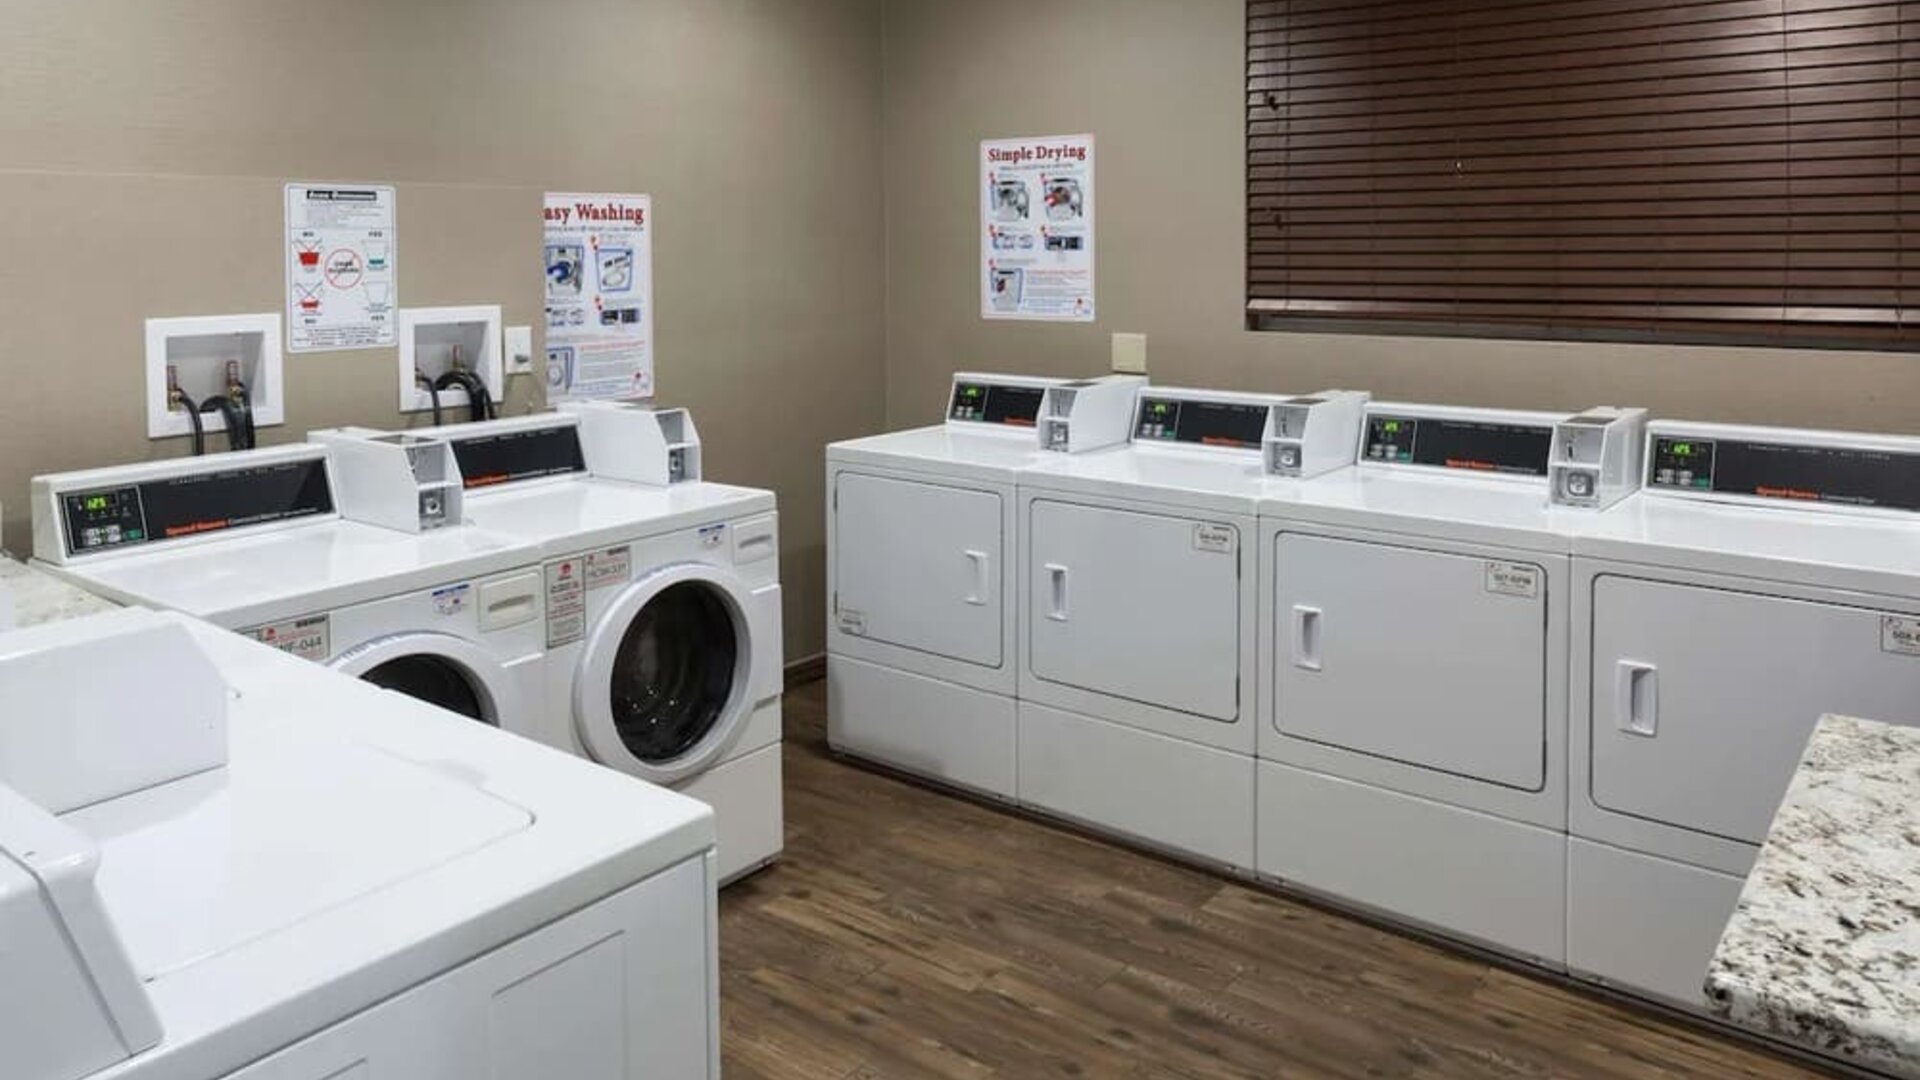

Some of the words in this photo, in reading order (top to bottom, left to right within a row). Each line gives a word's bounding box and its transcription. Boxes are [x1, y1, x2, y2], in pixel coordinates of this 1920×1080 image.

[988, 147, 1033, 164] Simple
[1036, 145, 1087, 161] Drying
[575, 203, 644, 224] Washing
